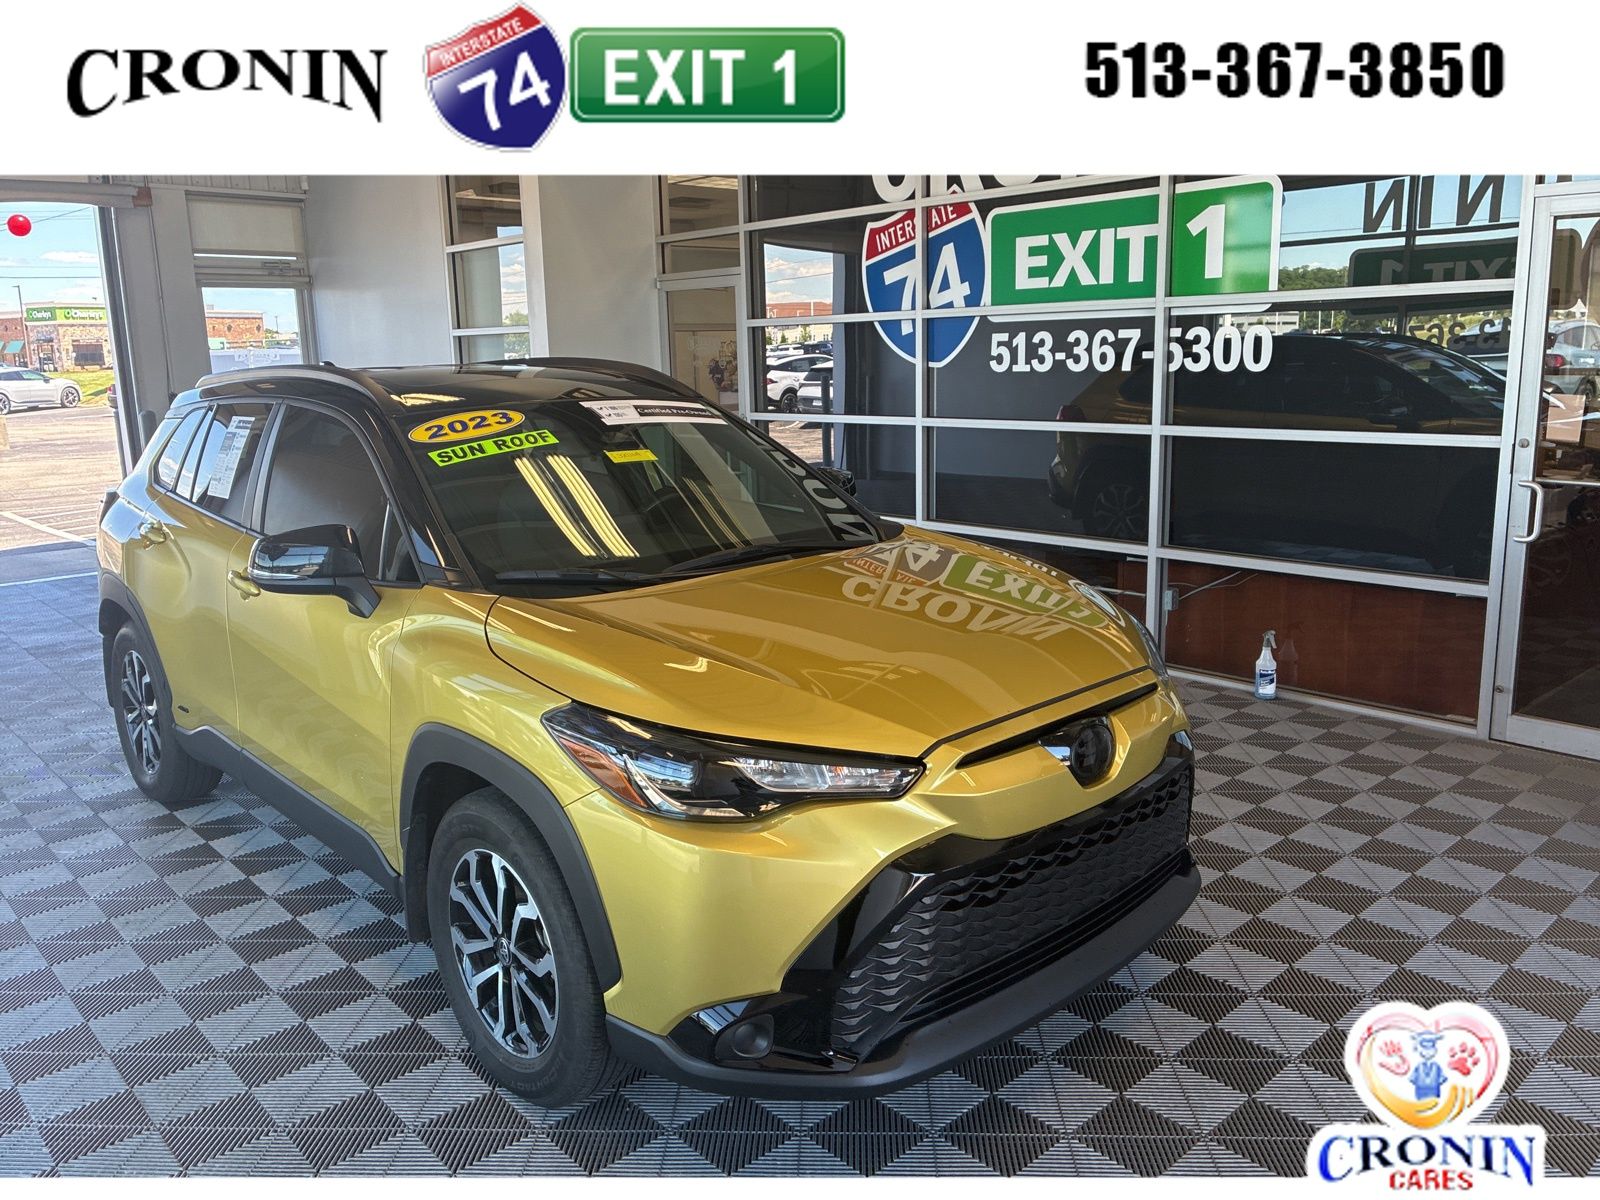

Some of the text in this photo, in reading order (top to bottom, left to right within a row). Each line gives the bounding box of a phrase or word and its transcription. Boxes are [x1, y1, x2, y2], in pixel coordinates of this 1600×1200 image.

[1015, 204, 1225, 290] EXIT 1
[883, 242, 970, 336] 74
[989, 325, 1273, 373] 513-367-5300
[424, 411, 514, 440] 2023
[436, 431, 550, 463] SUN ROOF
